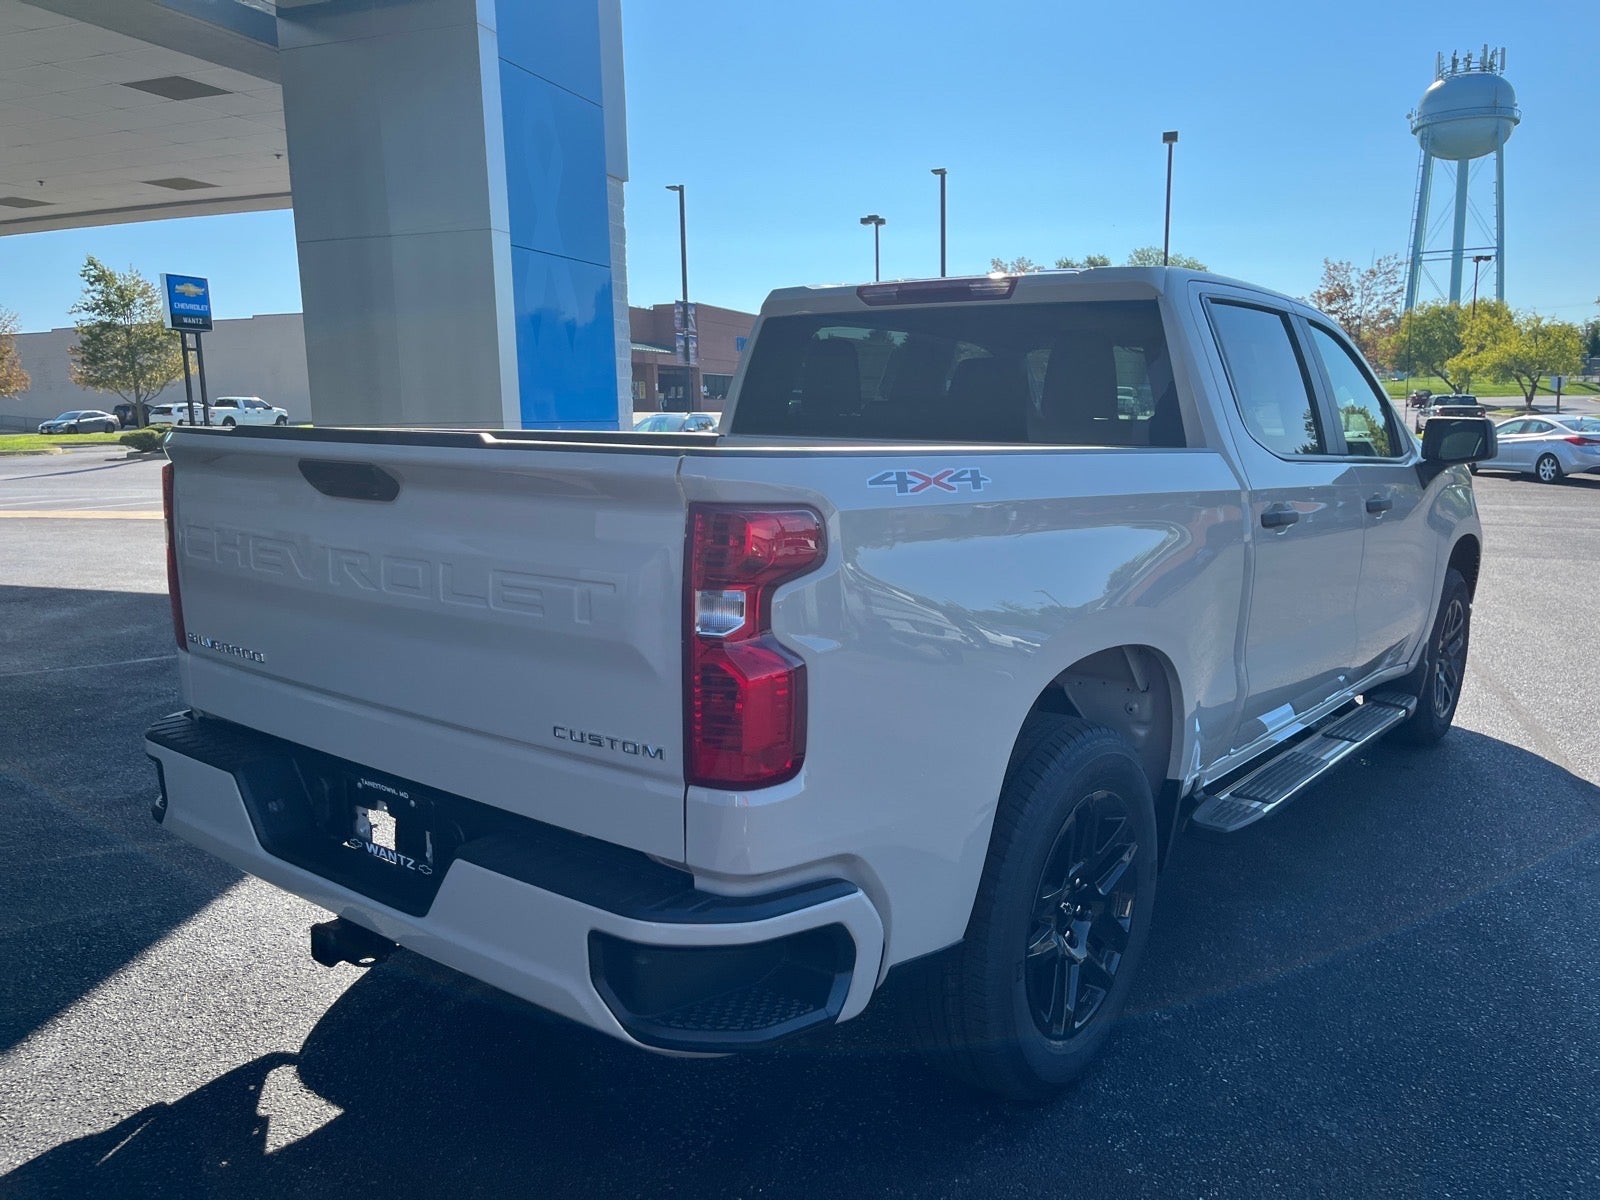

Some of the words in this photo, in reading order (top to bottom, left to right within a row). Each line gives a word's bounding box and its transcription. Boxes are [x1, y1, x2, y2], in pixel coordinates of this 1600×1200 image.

[174, 302, 208, 311] CHEVROLET
[183, 523, 618, 626] CHEVROLET
[187, 632, 265, 663] SILVERADO
[553, 725, 664, 760] CUSTOM
[365, 841, 416, 871] WANTZ
